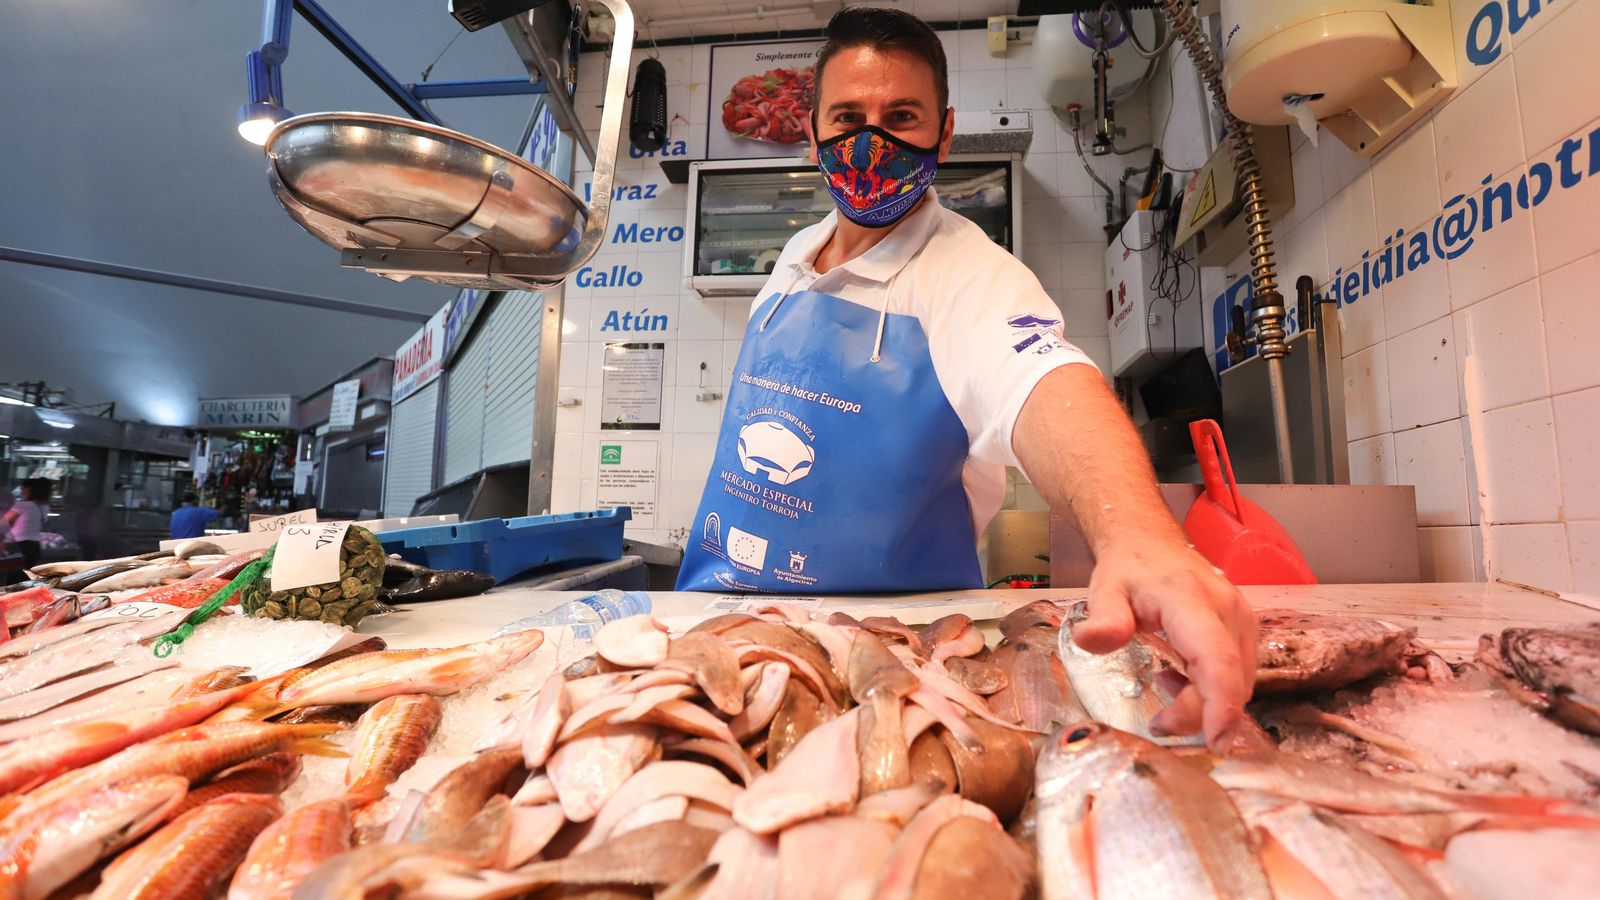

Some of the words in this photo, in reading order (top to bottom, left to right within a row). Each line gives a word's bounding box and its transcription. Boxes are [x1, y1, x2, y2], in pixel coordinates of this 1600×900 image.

[755, 51, 813, 62] Simplemente
[629, 138, 687, 159] Uta
[611, 223, 684, 244] Mero
[575, 265, 643, 288] Gallo
[600, 308, 668, 332] Atún
[740, 371, 752, 384] Una
[751, 375, 780, 391] manera
[780, 382, 791, 394] de
[791, 385, 820, 402] hacer
[820, 393, 862, 414] Europa
[201, 400, 287, 413] CHARCUTERIA
[206, 412, 282, 424] MARIN
[746, 407, 773, 420] CALIDAD
[778, 410, 816, 442] CONFIANZA
[720, 470, 761, 494] MERCADO
[763, 488, 814, 513] ESPECIAL
[736, 565, 761, 576] EUROPEA
[773, 568, 818, 582] Ayuntamiento
[784, 576, 813, 585] Algeciras
